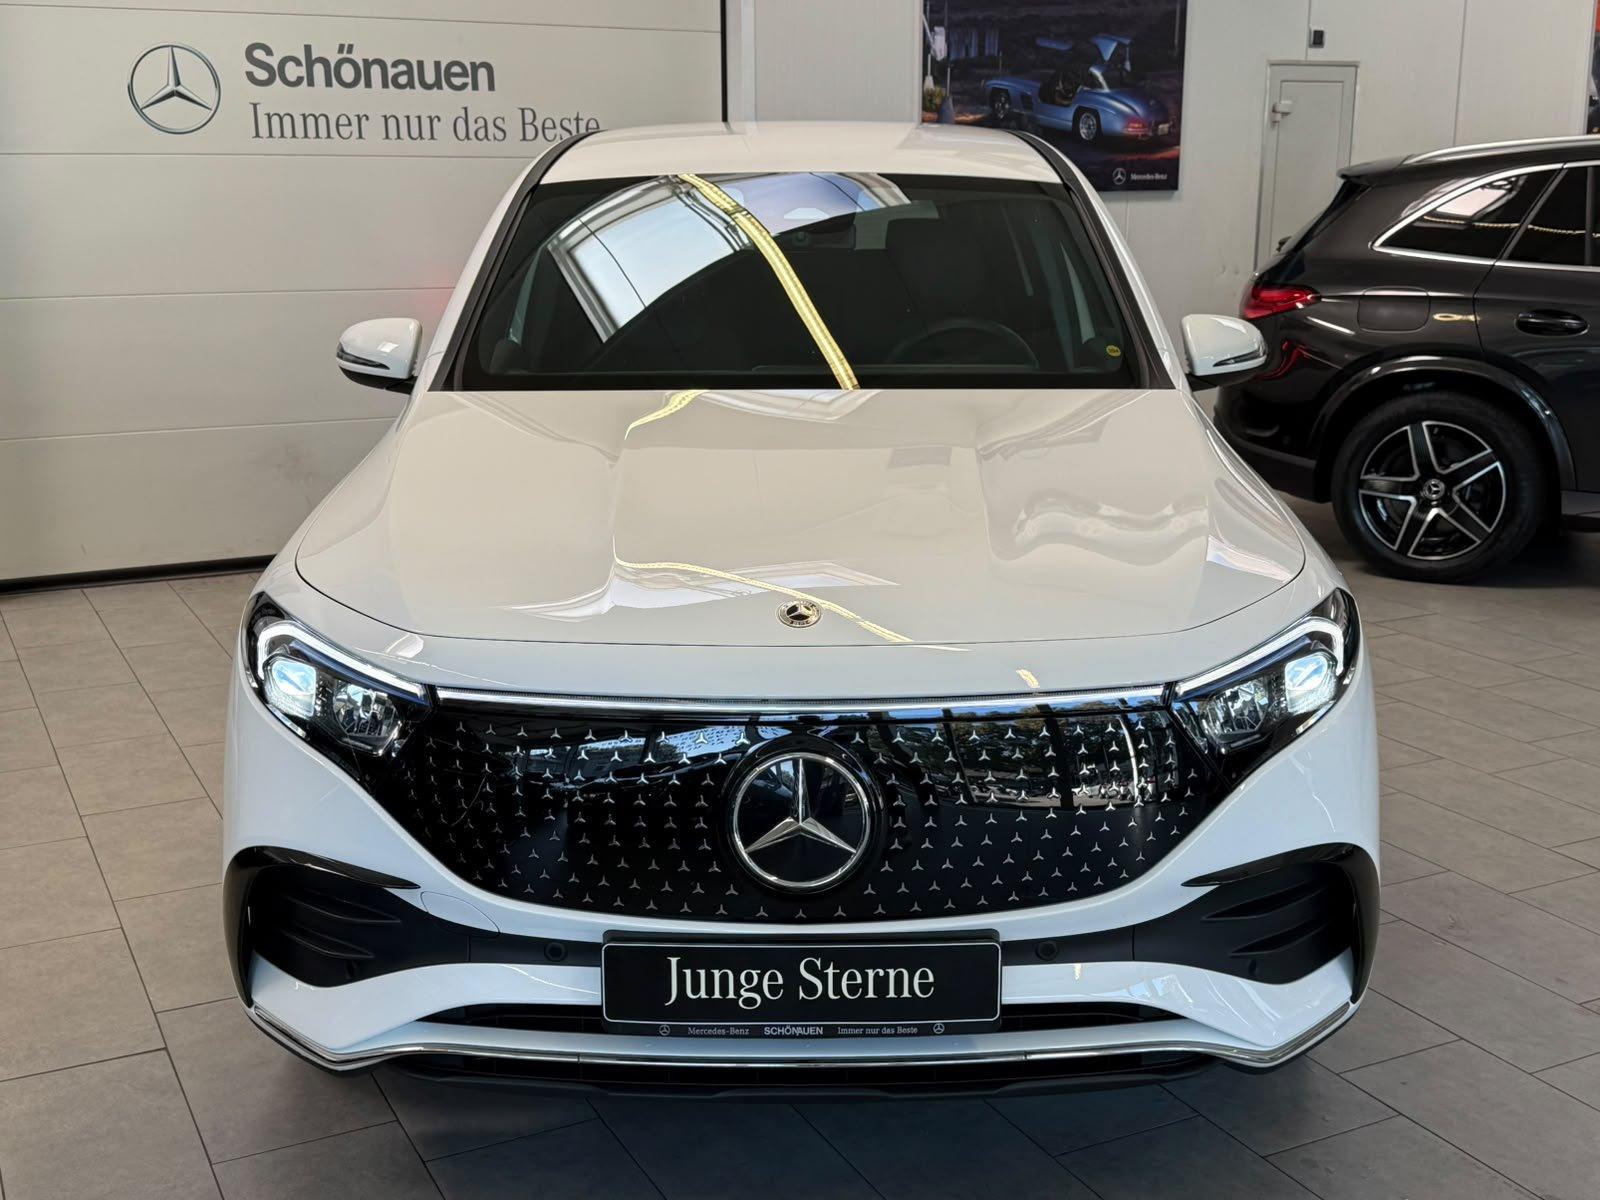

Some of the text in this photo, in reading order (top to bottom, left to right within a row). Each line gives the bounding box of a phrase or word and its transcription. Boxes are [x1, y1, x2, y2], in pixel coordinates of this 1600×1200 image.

[244, 42, 496, 92] Schönauen
[249, 102, 370, 141] Immer
[381, 113, 441, 142] nur
[452, 106, 507, 142] das
[664, 956, 935, 1010] Junge Sterne
[687, 1026, 750, 1036] Mercedes-Benz
[763, 1025, 824, 1036] SCHÖNAUEN
[837, 1025, 918, 1035] Immer nur das Beste
